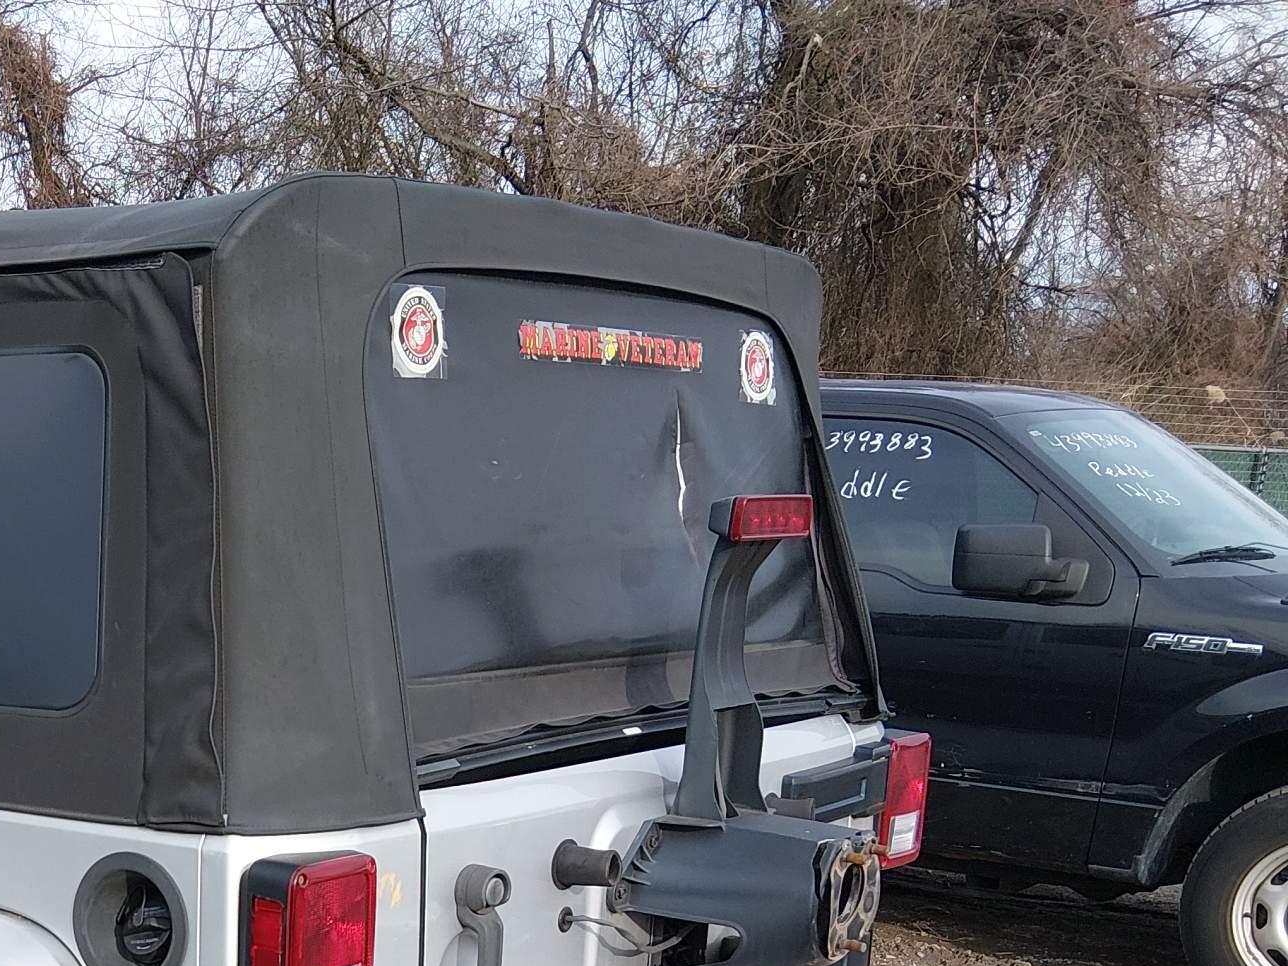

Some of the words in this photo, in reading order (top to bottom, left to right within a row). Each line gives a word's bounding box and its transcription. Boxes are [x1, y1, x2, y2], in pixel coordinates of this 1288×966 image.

[519, 324, 602, 359] MARINE
[616, 332, 703, 369] VETERAN
[1115, 482, 1182, 506] 12/23
